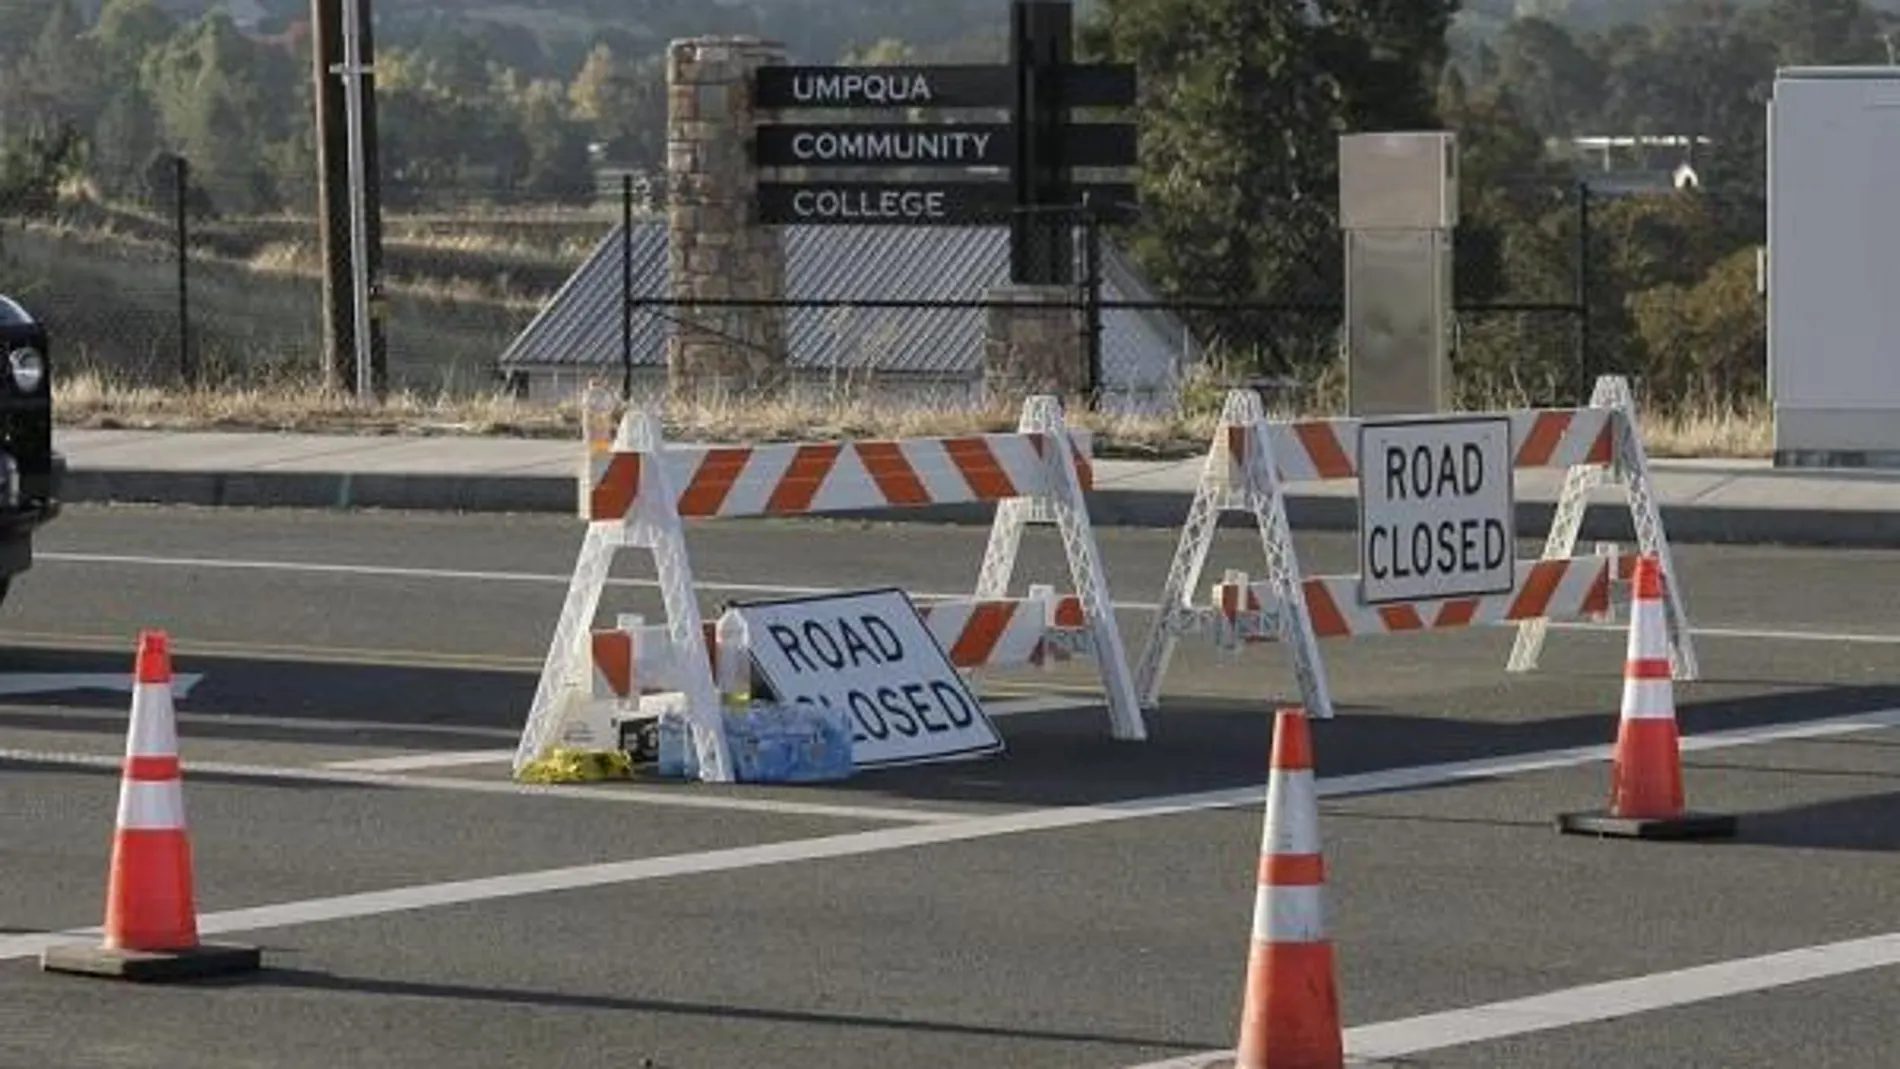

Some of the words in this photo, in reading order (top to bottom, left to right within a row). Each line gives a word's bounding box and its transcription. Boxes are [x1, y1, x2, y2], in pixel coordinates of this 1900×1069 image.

[792, 73, 932, 102] UMPQUA
[792, 132, 992, 160] COMMUNITY
[793, 190, 945, 218] COLLEGE
[1386, 442, 1484, 500] ROAD
[1368, 517, 1506, 580] CLOSED
[767, 615, 905, 673] ROAD
[796, 680, 973, 743] OSED
